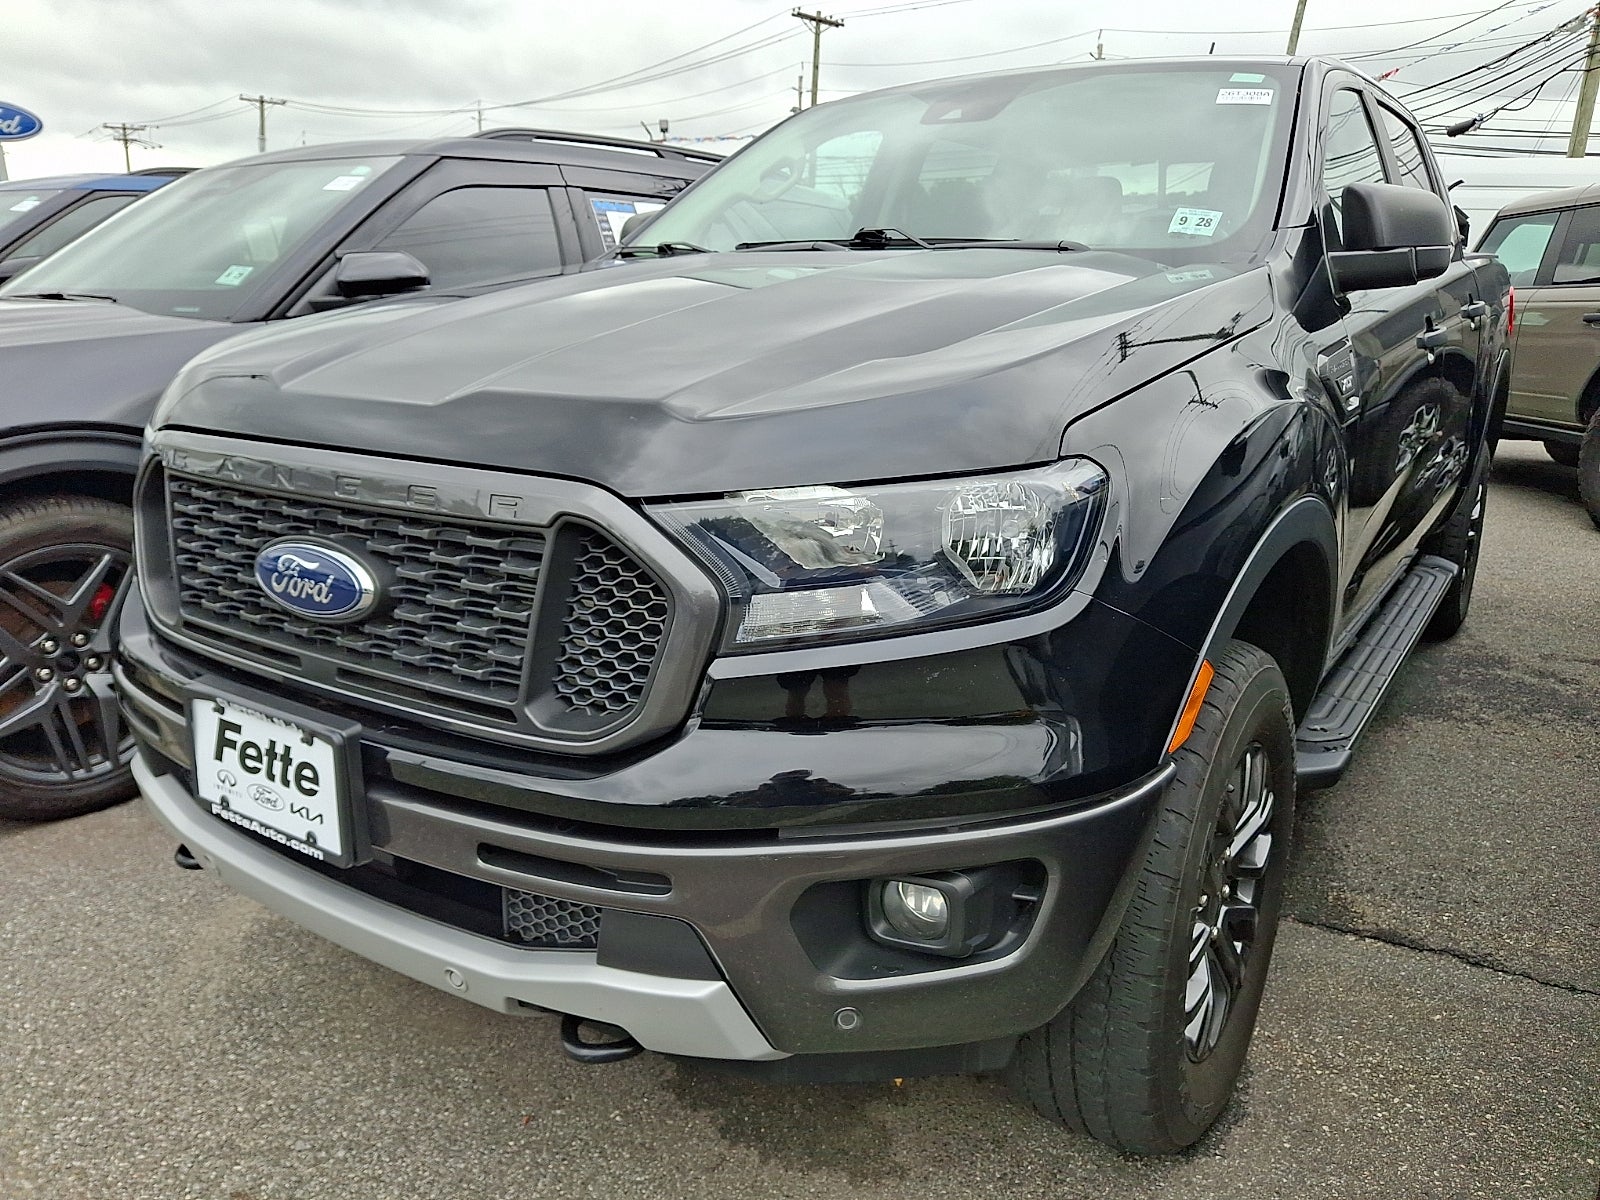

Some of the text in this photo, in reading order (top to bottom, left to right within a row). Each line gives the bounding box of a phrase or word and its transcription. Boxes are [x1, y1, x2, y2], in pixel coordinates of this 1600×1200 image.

[1178, 216, 1213, 228] 9 28
[270, 553, 334, 604] Ford
[214, 717, 320, 797] Fette
[211, 802, 324, 861] FetteAuto.com
[290, 802, 324, 825] KIA
